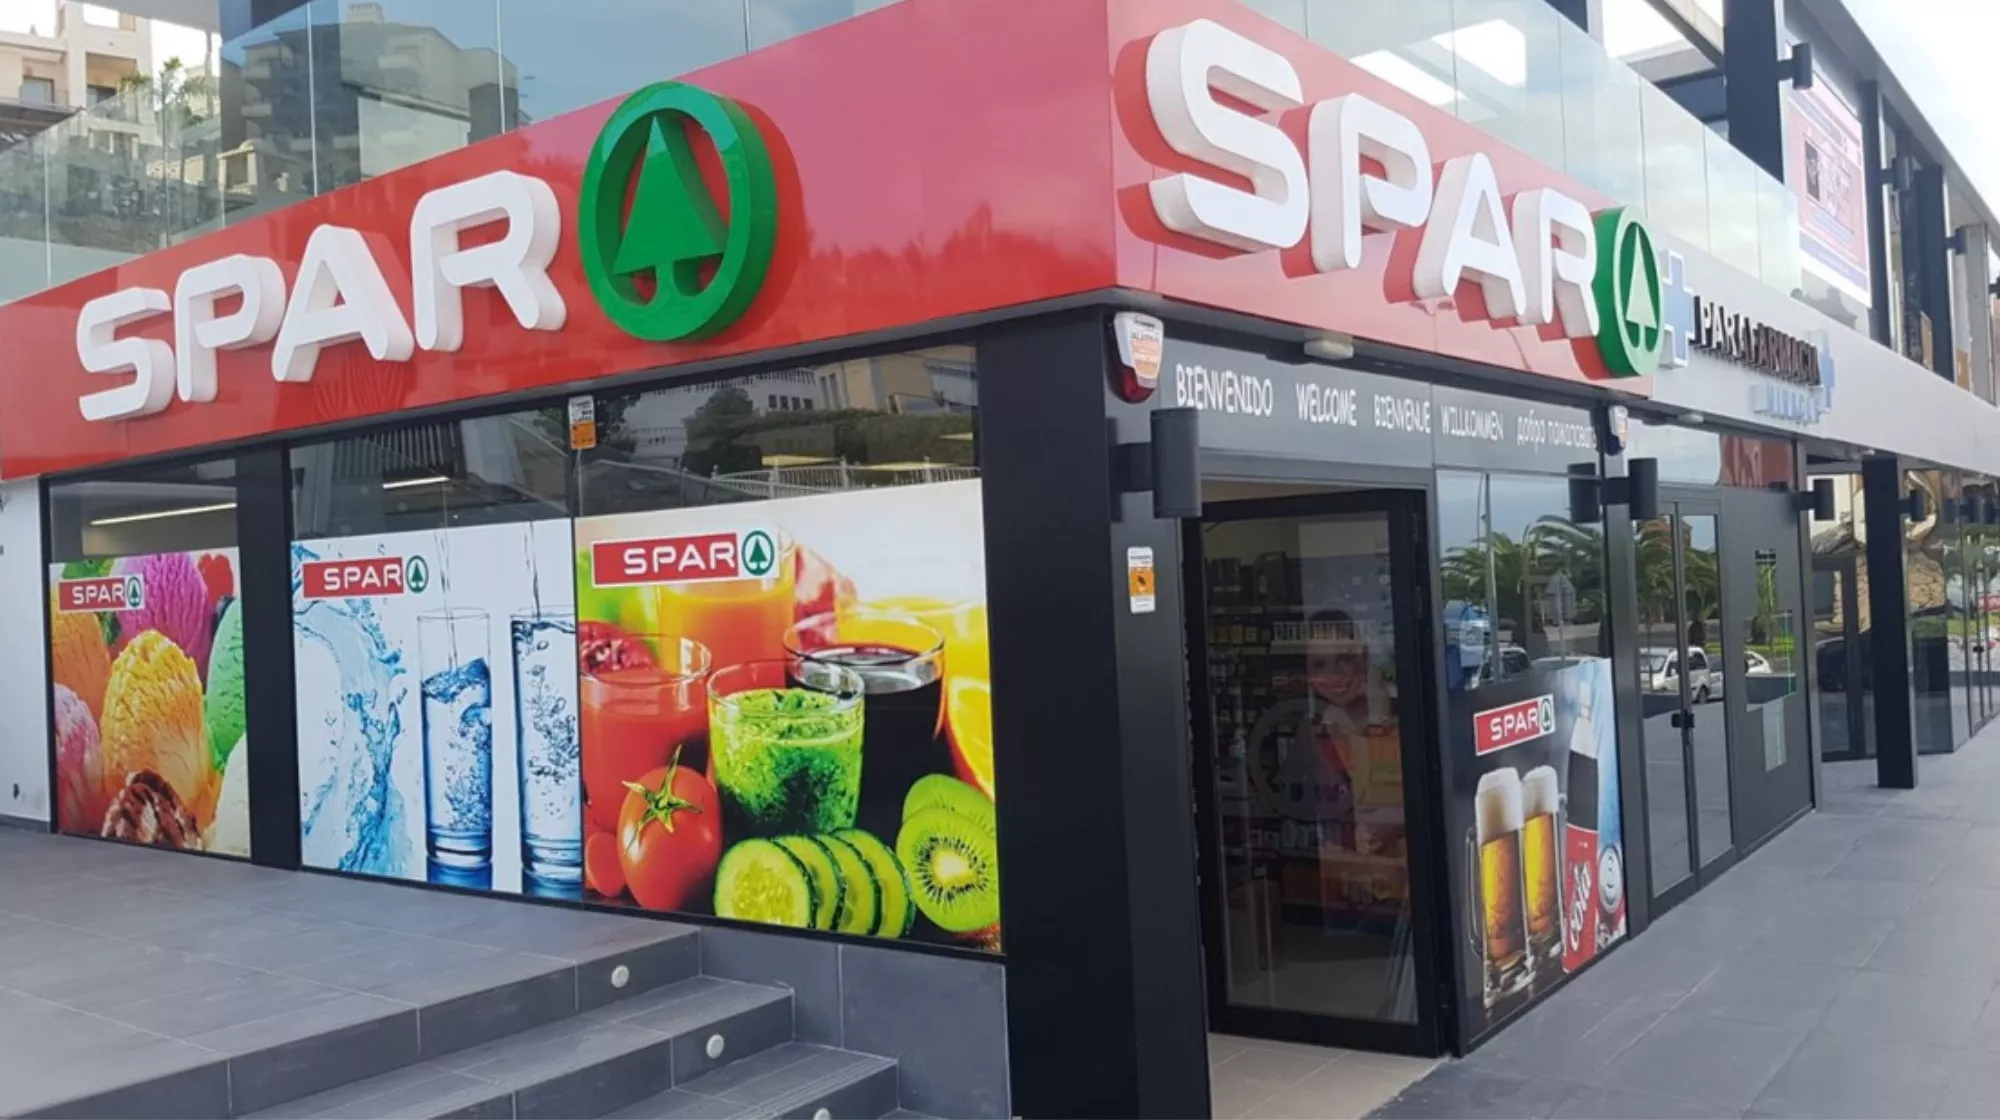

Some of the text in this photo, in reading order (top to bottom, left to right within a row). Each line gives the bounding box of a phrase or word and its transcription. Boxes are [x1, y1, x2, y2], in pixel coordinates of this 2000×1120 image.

[1146, 18, 1600, 338] SPAR
[76, 169, 567, 421] SPAR
[1694, 295, 1821, 386] PARAFARMACIA
[1175, 363, 1504, 441] BIENVENIDO WELCOME BIENVENUE WILLKOMMEN
[323, 563, 402, 592] SPAR
[623, 541, 736, 576] SPAR
[71, 582, 124, 606] SPAR
[1489, 707, 1539, 742] SPAR
